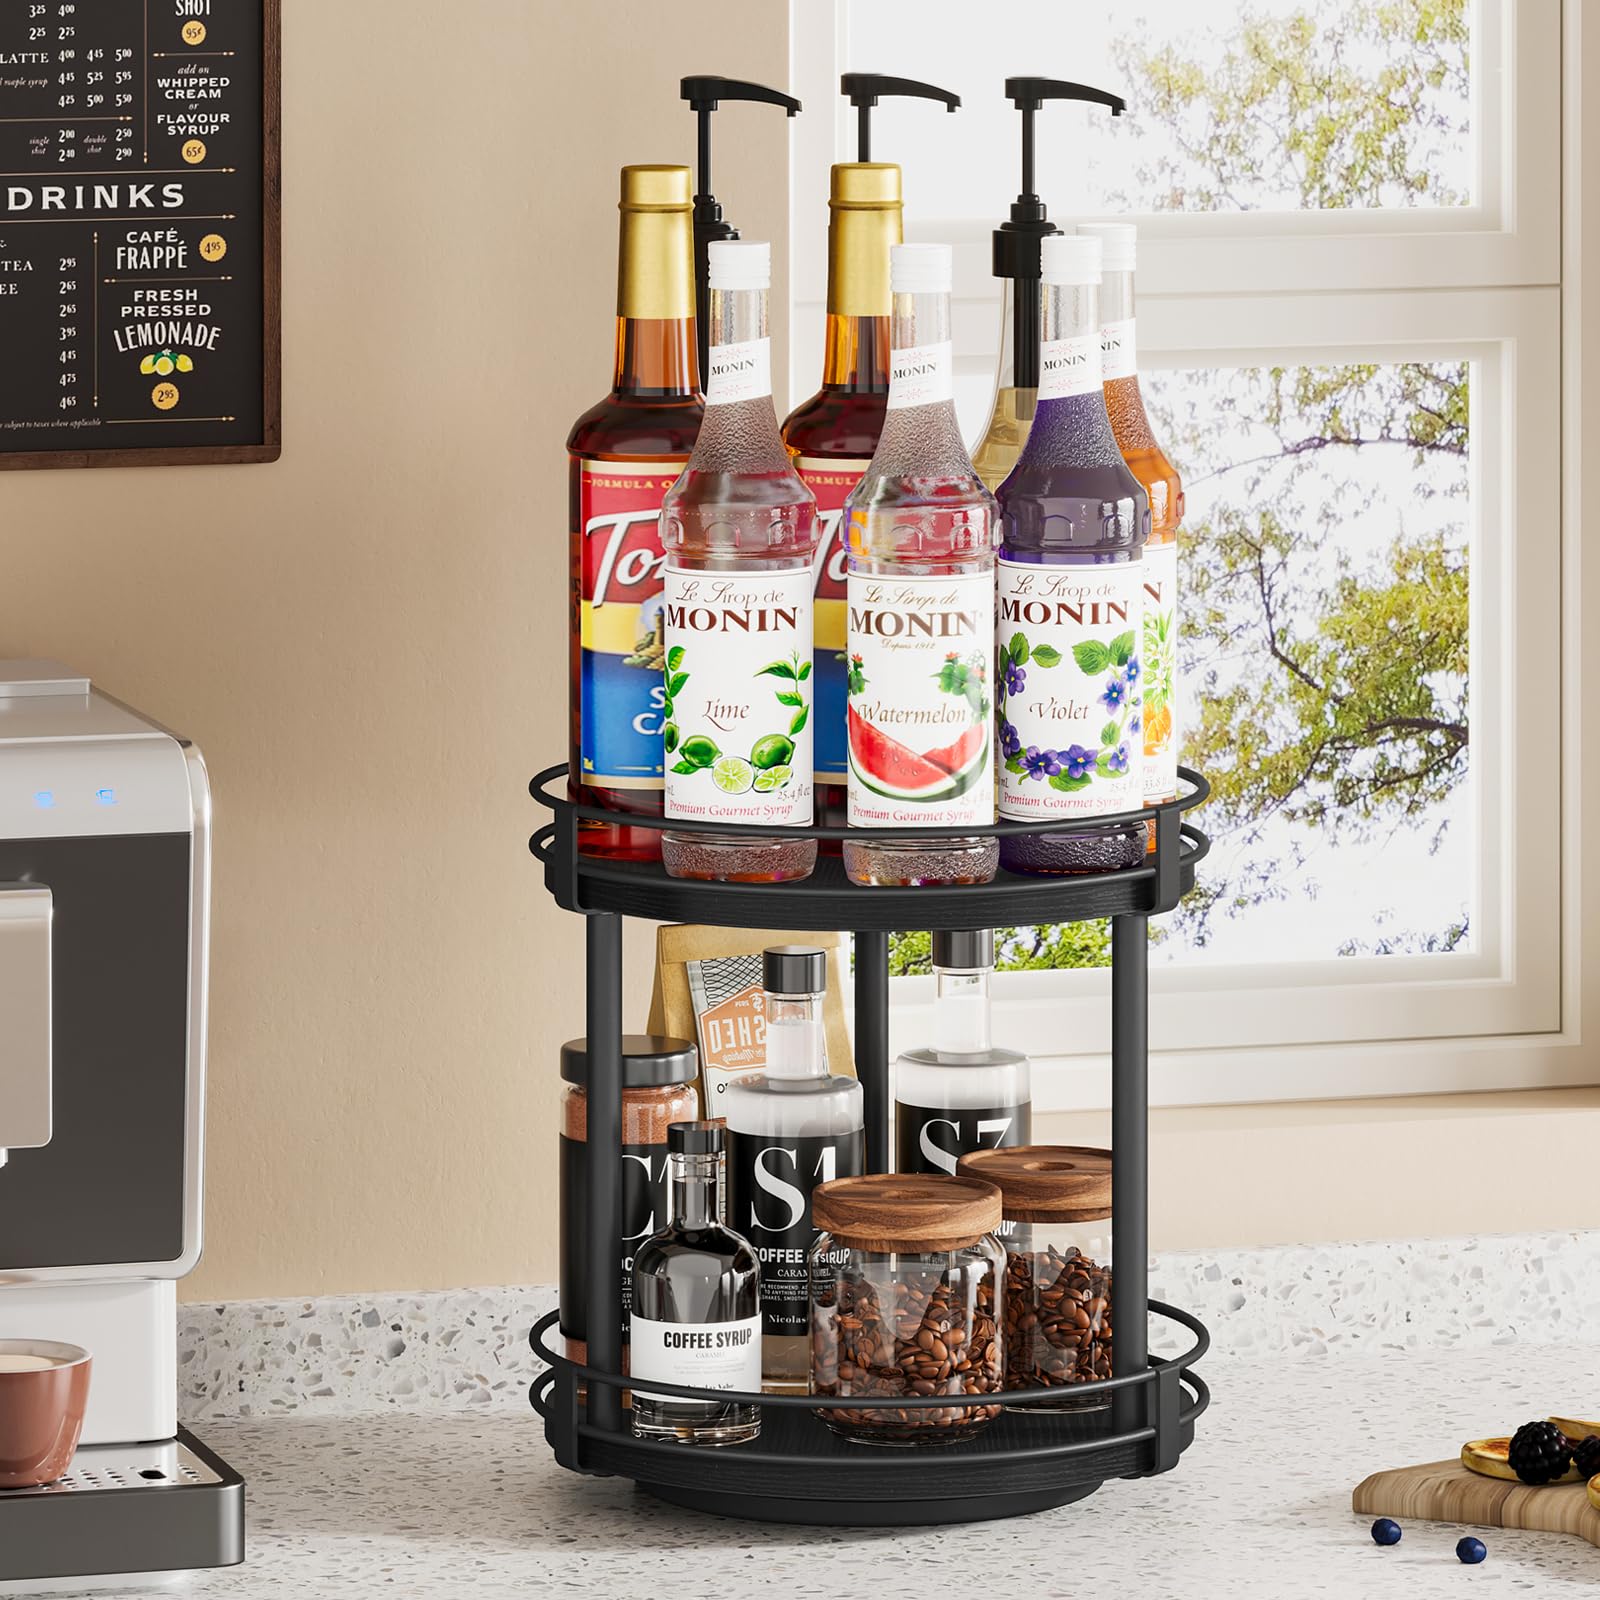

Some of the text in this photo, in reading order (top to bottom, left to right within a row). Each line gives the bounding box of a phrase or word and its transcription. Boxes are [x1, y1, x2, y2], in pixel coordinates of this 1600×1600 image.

[0, 52, 49, 64] LATTE
[177, 64, 197, 75] add
[157, 77, 230, 88] WHIPPED
[165, 89, 221, 100] CREAM
[157, 113, 231, 125] FLAVOUR
[167, 125, 220, 136] SYRUP
[8, 183, 185, 211] DRINKS
[126, 227, 179, 243] CAFÉ
[116, 240, 188, 270] FRAPPÉ
[1, 260, 34, 272] TEA
[134, 289, 198, 302] FRESH
[121, 304, 212, 318] PRESSED
[113, 321, 222, 352] LEMONADE
[711, 359, 754, 376] MONIN
[893, 362, 936, 380] MONIN
[1043, 353, 1087, 371] MONIN
[591, 479, 654, 489] FORMULA
[676, 581, 784, 609] Le Sirop de
[1010, 574, 1116, 602] Le Sirop de
[864, 585, 958, 610] Le Sirop de
[667, 604, 798, 632] MONIN
[1001, 597, 1129, 625] MONIN
[850, 607, 977, 637] MONIN
[702, 698, 750, 732] Lime
[858, 701, 966, 724] Watermelon
[1029, 697, 1089, 720] Violet
[1004, 791, 1040, 806] Premium
[1043, 796, 1093, 808] Gourmet
[669, 799, 793, 821] Premium Gourmet Syrup
[853, 805, 975, 825] Premium Gourmet Syrup
[768, 1314, 806, 1324] Nicolas
[664, 1328, 752, 1349] COFFEE SYRUP
